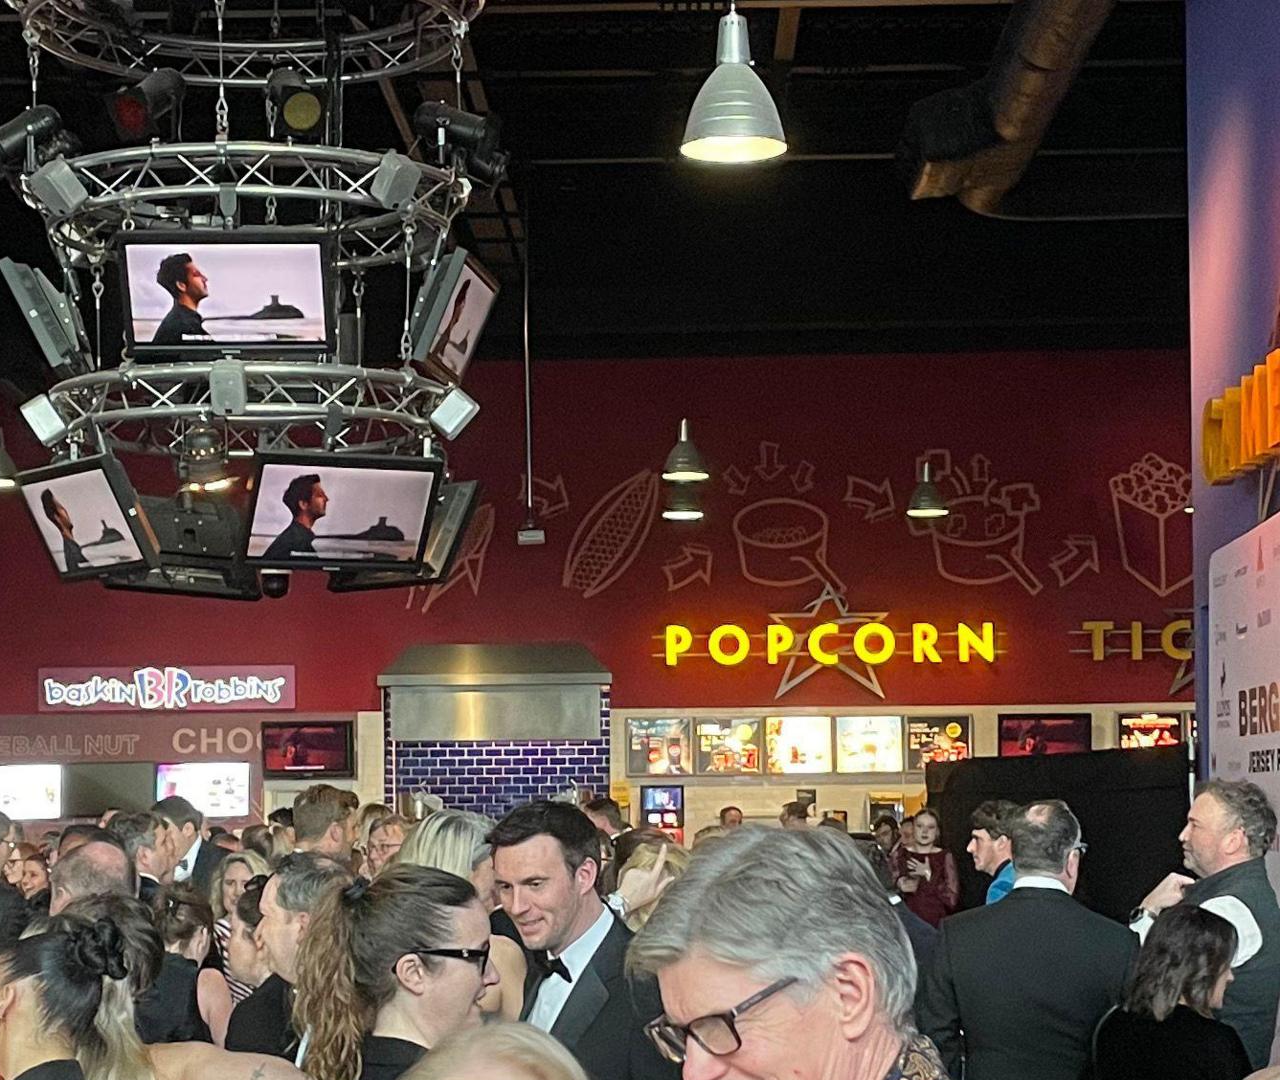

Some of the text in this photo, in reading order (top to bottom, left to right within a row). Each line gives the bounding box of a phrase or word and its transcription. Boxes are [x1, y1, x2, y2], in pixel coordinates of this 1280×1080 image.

[664, 621, 996, 667] POPCORN
[44, 667, 286, 709] baskin BR robbins
[84, 734, 140, 756] NUT
[172, 727, 263, 755] CHO
[1248, 748, 1276, 774] JERSEY
